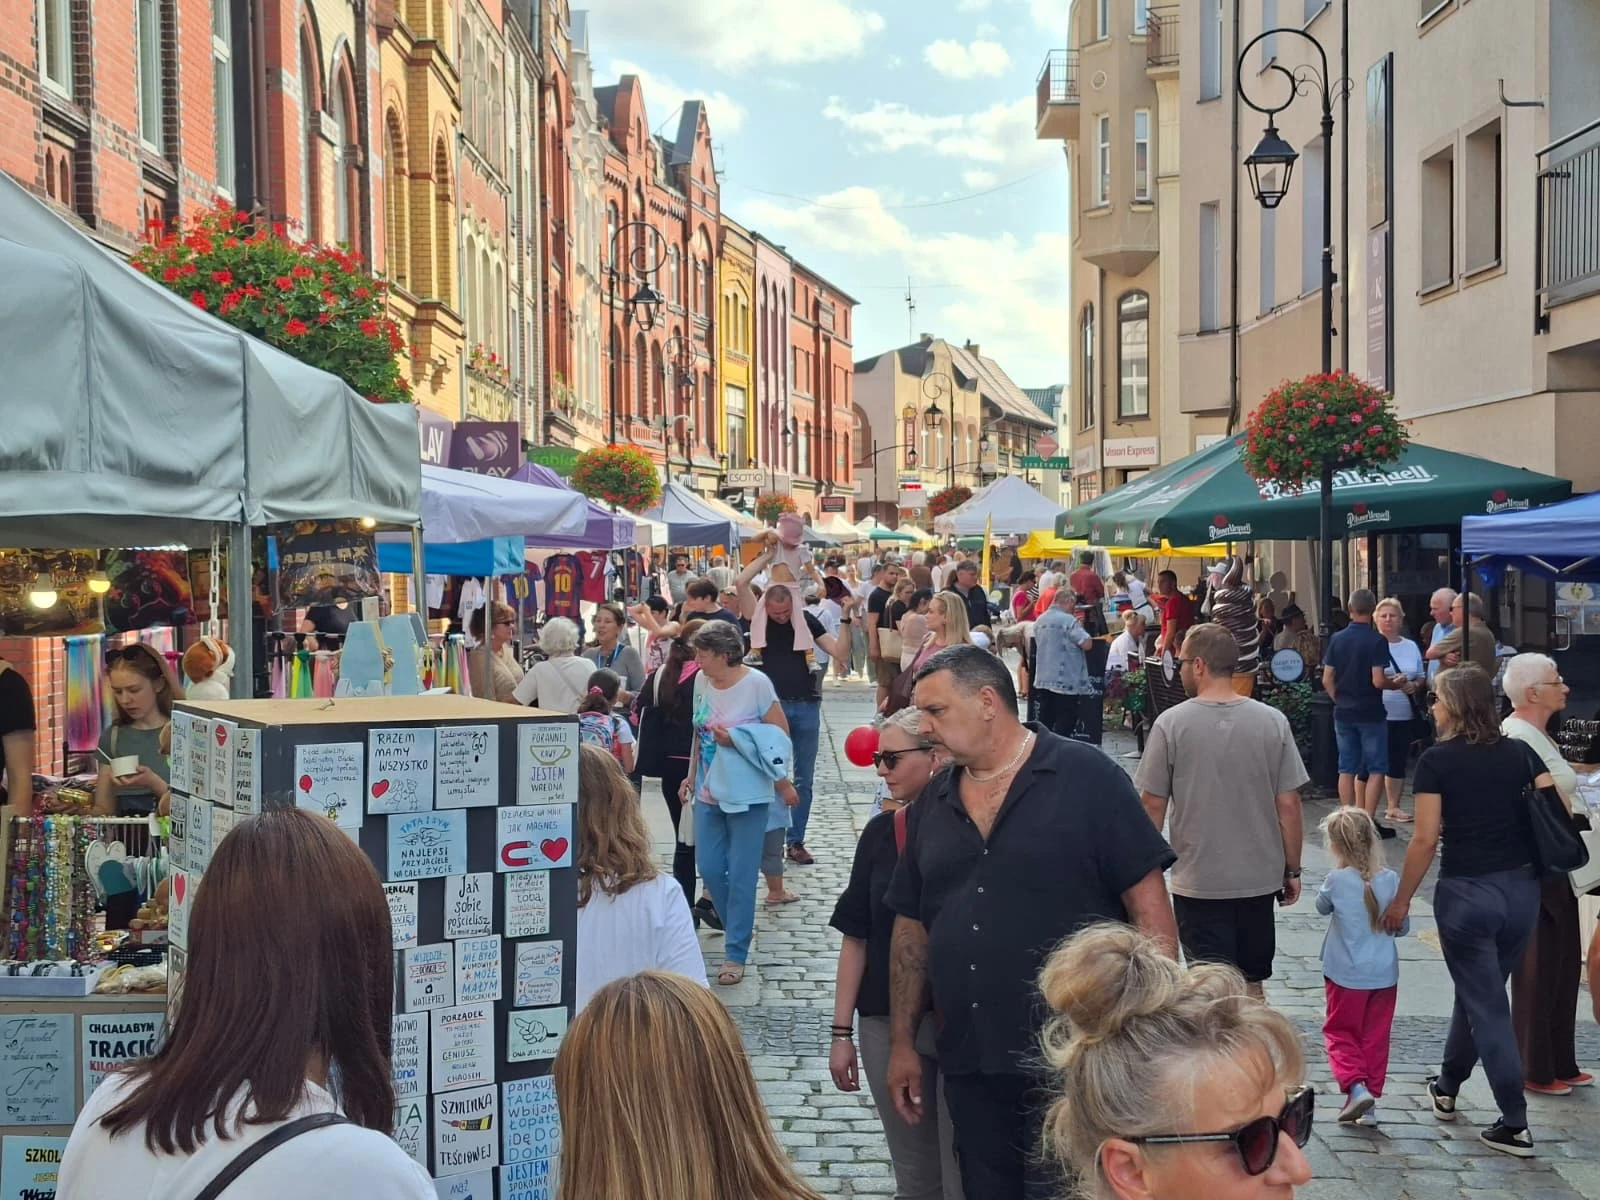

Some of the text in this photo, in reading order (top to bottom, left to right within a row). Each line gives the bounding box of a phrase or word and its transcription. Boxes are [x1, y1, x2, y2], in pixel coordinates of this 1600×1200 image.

[418, 424, 444, 464] LAY
[1105, 446, 1155, 458] Vision Express
[591, 561, 601, 579] 7
[555, 573, 571, 593] 10
[378, 733, 415, 744] RAZEM
[375, 748, 410, 757] MAMY
[379, 759, 428, 771] WSZYSTKO
[531, 766, 565, 781] JESTEM
[507, 821, 558, 833] JAK MAGNES
[402, 847, 448, 859] NAJLEPSI
[459, 876, 480, 897] Jak
[455, 897, 482, 914] sobie
[462, 940, 498, 953] TEGO
[474, 969, 497, 978] MOŻE
[463, 981, 498, 994] MAŁYM
[441, 1010, 484, 1024] PORZĄDEK
[89, 1023, 155, 1034] CHCIAŁABYM
[89, 1034, 156, 1058] TRACIĆ
[442, 1048, 476, 1061] GENIUSZ
[441, 1093, 492, 1115] SZMINKA
[442, 1134, 456, 1143] DLA
[535, 1127, 560, 1142] DO
[440, 1144, 491, 1166] TEŚCIOWEJ
[510, 1142, 560, 1162] DOMU
[508, 1160, 549, 1182] JESTEM
